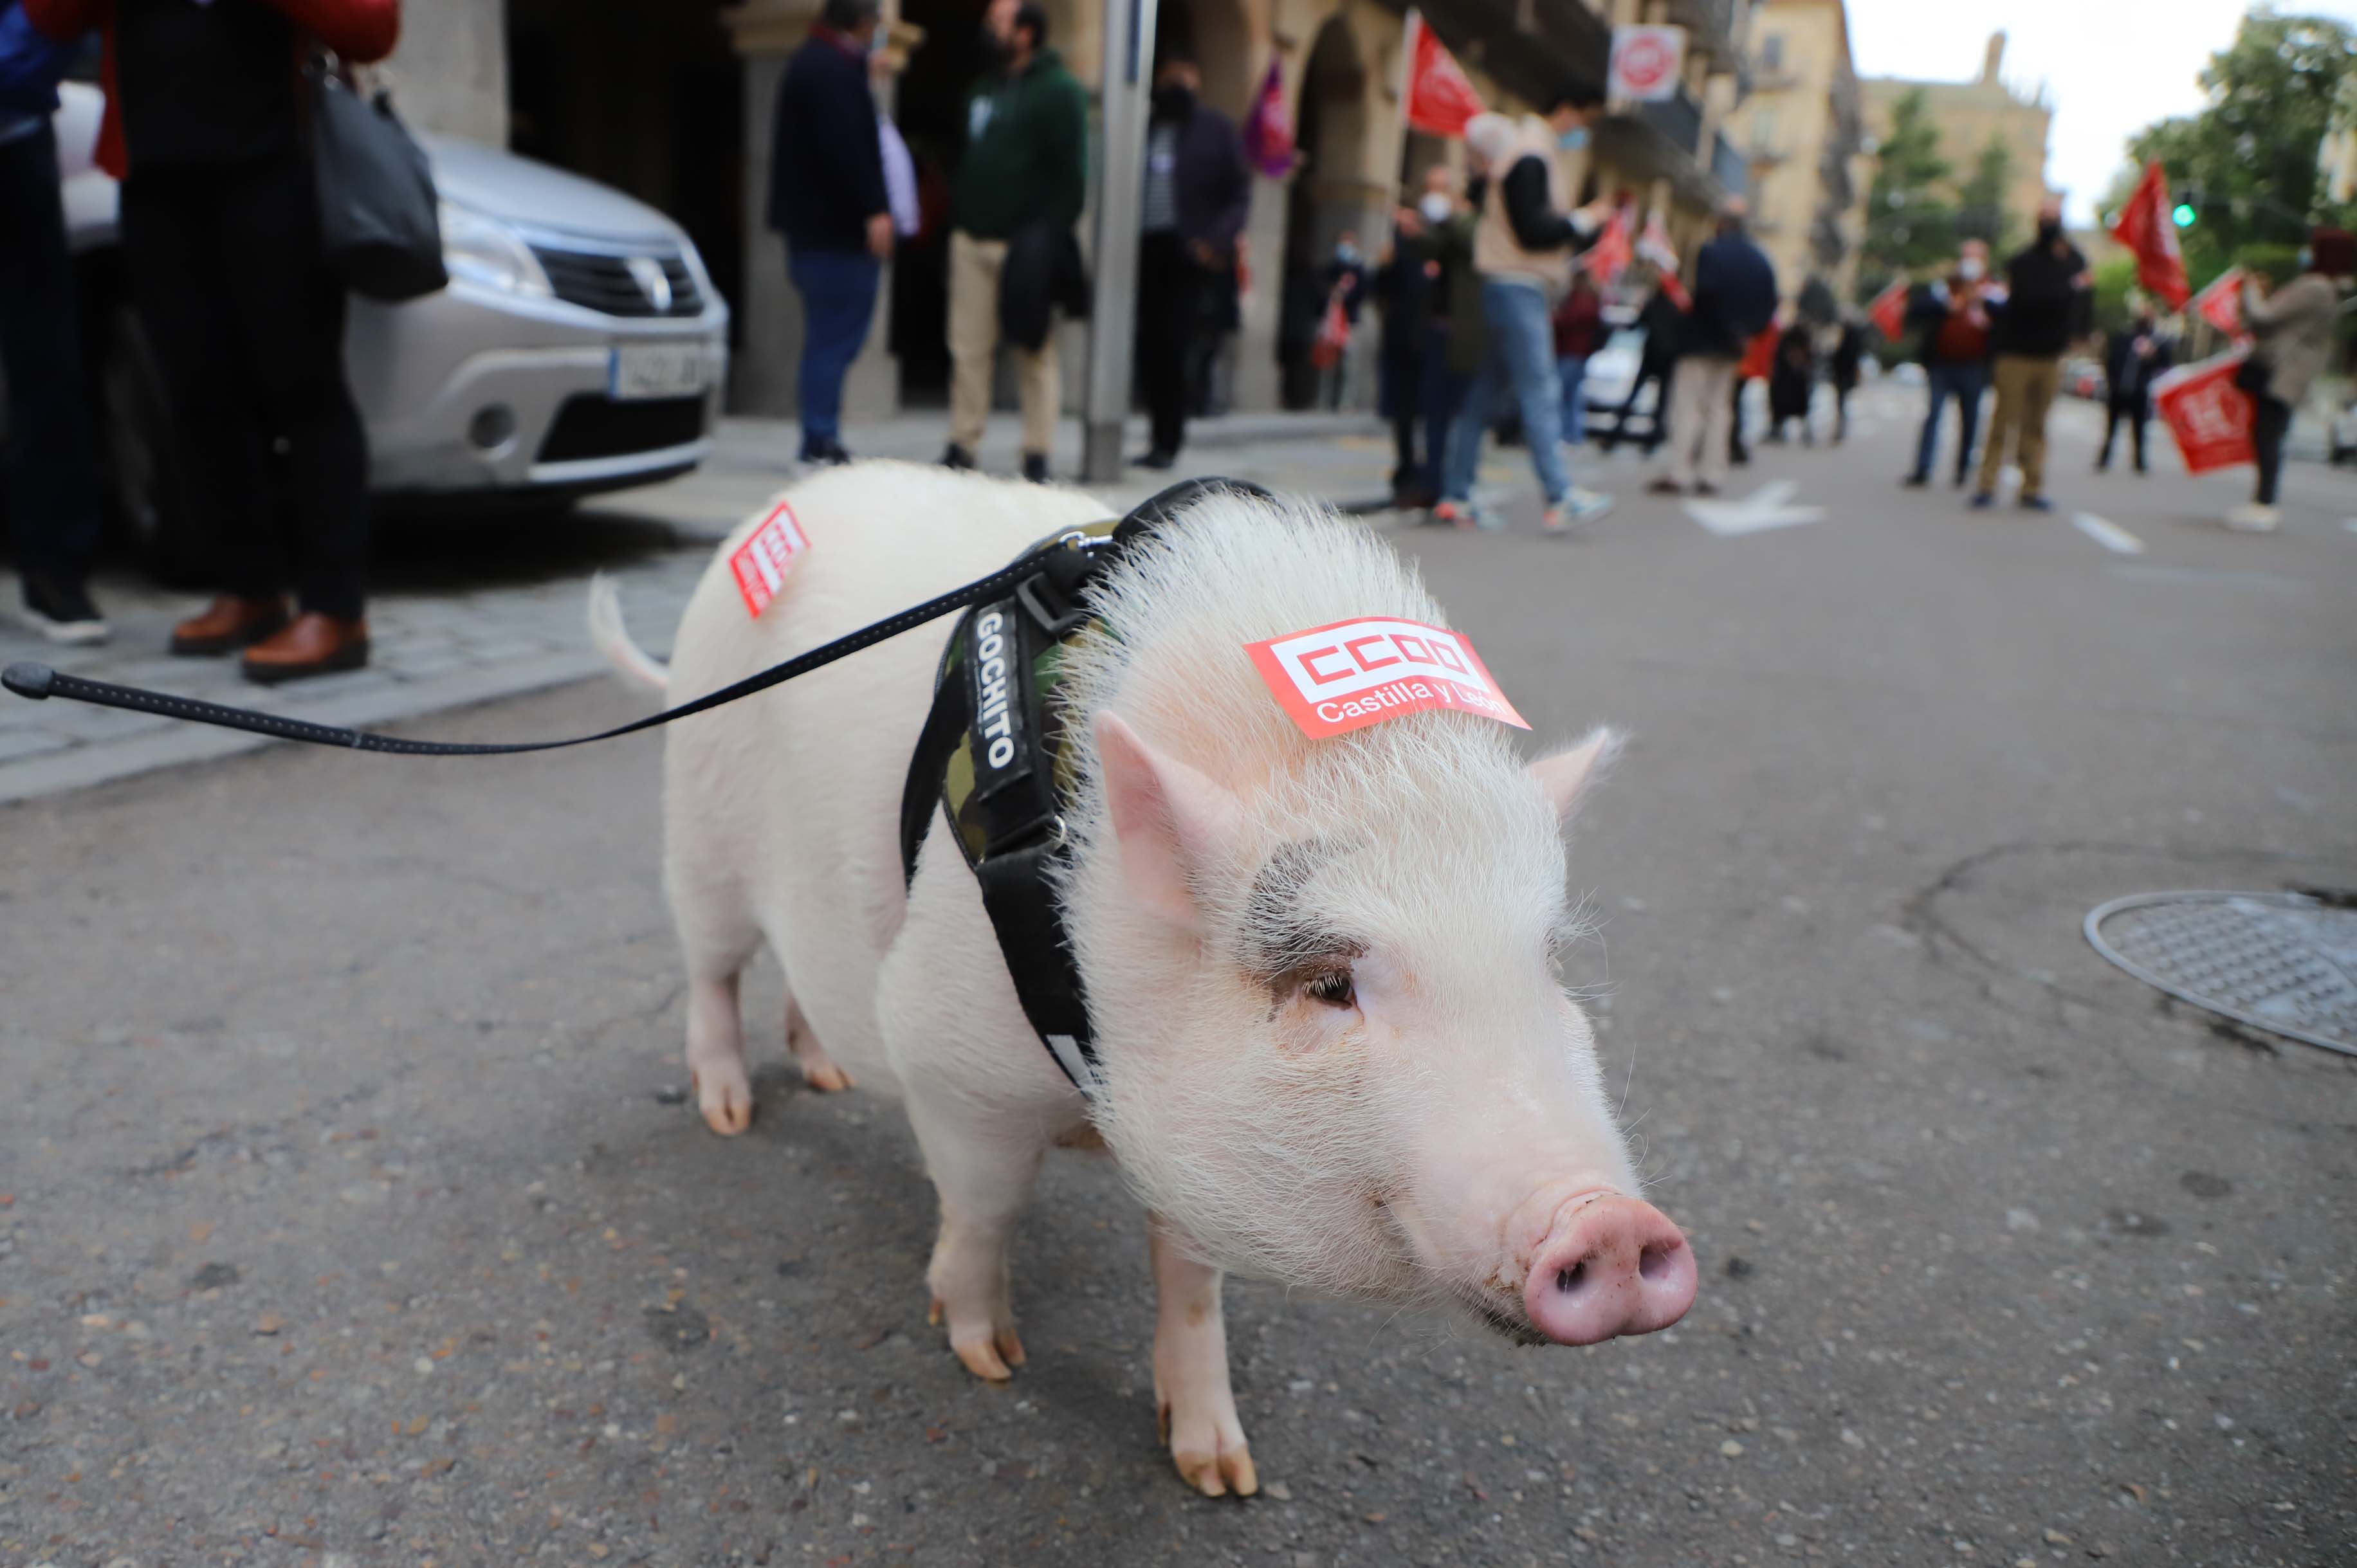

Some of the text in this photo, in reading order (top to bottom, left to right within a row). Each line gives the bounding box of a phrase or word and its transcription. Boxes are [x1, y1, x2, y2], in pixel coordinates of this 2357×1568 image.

[1297, 634, 1470, 686] CCOO
[977, 612, 1014, 769] GOCHITO
[1317, 682, 1434, 723] Castilla
[1432, 683, 1451, 703] y
